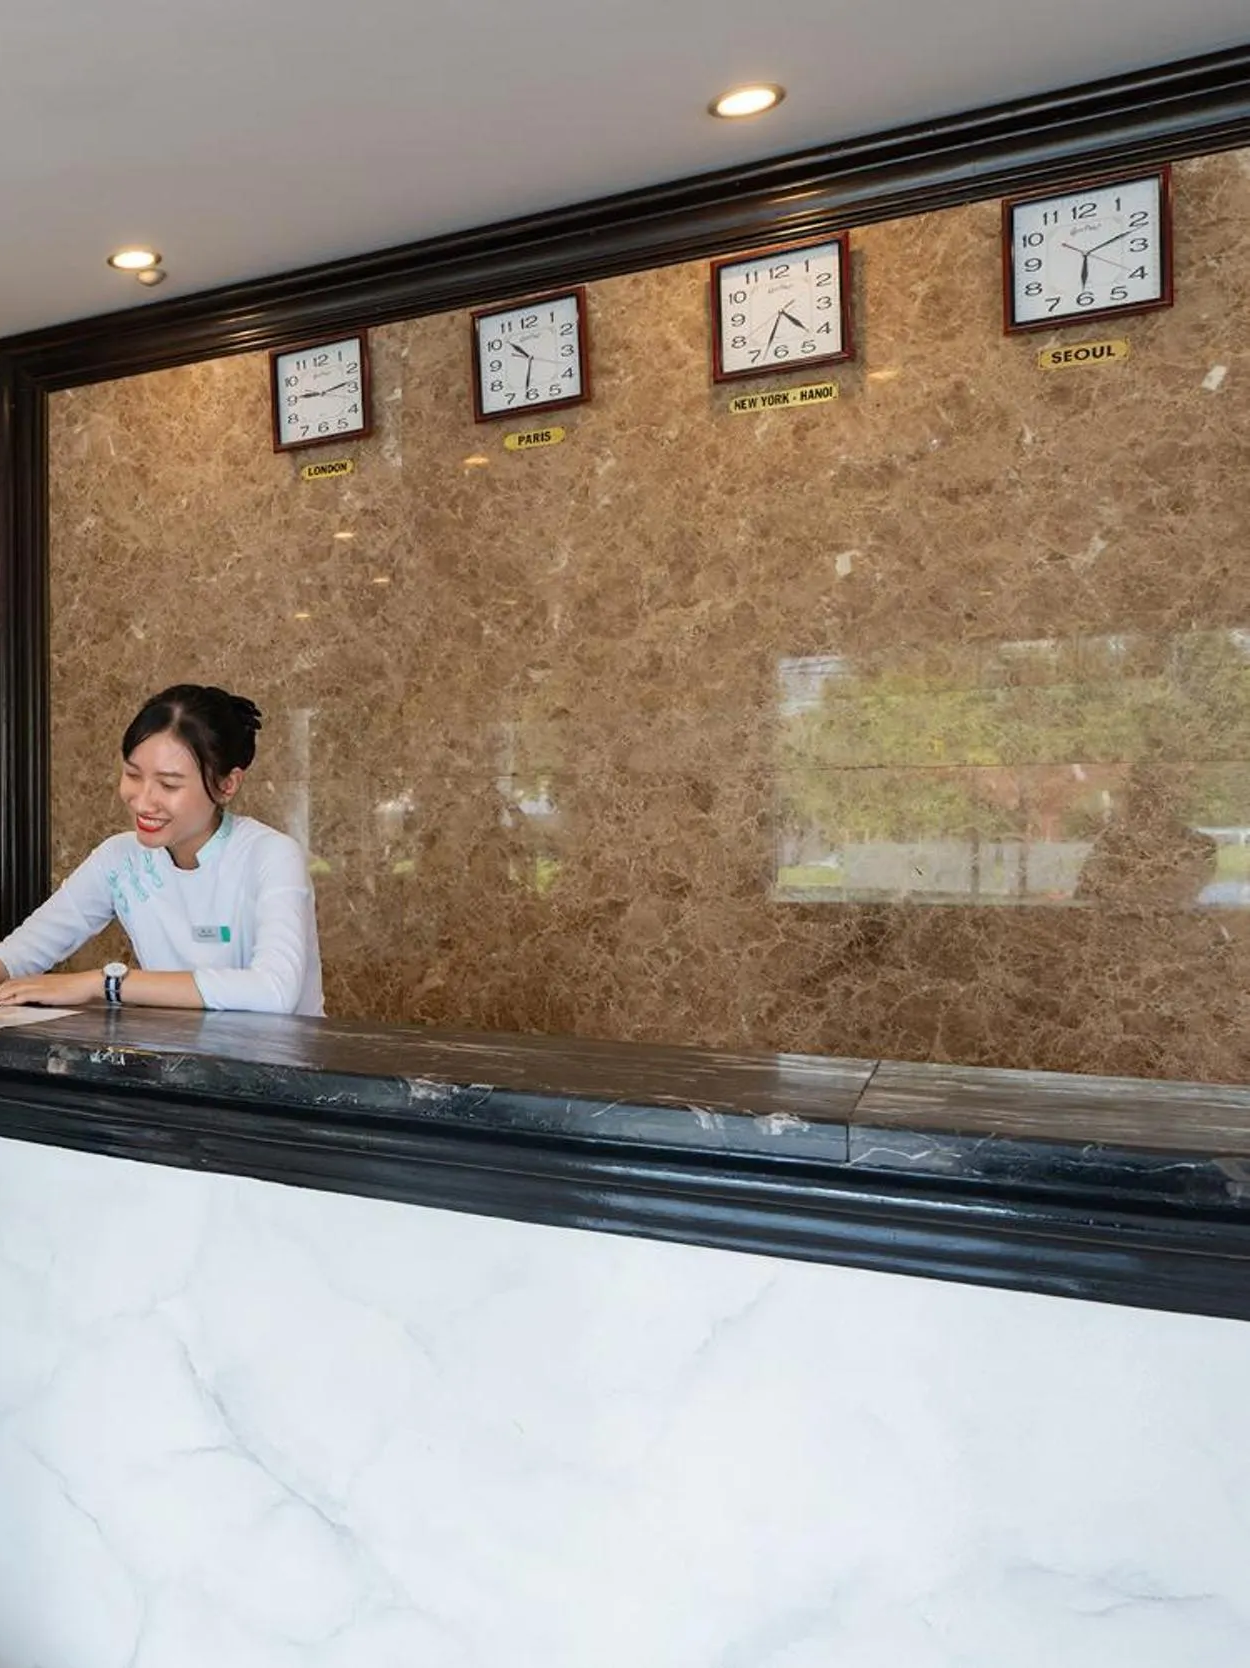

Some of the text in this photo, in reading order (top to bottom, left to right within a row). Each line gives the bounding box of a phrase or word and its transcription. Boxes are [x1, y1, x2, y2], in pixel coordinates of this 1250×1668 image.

[1042, 210, 1059, 226] 11
[1071, 202, 1098, 220] 12
[1128, 211, 1149, 228] 2
[1022, 232, 1044, 248] 10
[1129, 238, 1149, 252] 3
[768, 264, 790, 280] 12
[1024, 258, 1043, 272] 9
[745, 270, 758, 285] 11
[1128, 265, 1148, 280] 4
[816, 272, 832, 288] 2
[1024, 282, 1043, 296] 8
[1110, 286, 1128, 301] 5
[728, 290, 747, 305] 10
[816, 296, 832, 310] 3
[1045, 296, 1061, 312] 7
[1076, 292, 1095, 307] 6
[520, 315, 538, 330] 12
[730, 312, 746, 328] 9
[500, 322, 512, 334] 11
[560, 322, 574, 337] 2
[816, 321, 832, 334] 4
[487, 339, 503, 352] 10
[731, 335, 747, 349] 8
[800, 339, 817, 354] 5
[560, 344, 574, 358] 3
[748, 350, 761, 364] 7
[773, 344, 790, 359] 6
[1051, 344, 1116, 365] SEOUL
[296, 360, 306, 371] 11
[312, 354, 329, 368] 12
[346, 360, 358, 374] 2
[490, 360, 502, 372] 9
[561, 367, 574, 379] 4
[284, 376, 299, 388] 10
[347, 380, 359, 394] 3
[490, 380, 504, 392] 8
[525, 388, 540, 401] 6
[549, 383, 562, 397] 5
[286, 394, 298, 407] 9
[504, 392, 516, 406] 7
[734, 397, 757, 410] NEW
[760, 392, 790, 407] YORK
[799, 386, 833, 402] HANOI
[348, 403, 358, 414] 4
[287, 413, 299, 424] 8
[337, 418, 349, 430] 5
[300, 425, 309, 437] 7
[318, 421, 330, 433] 6
[517, 431, 552, 446] PARIS
[307, 462, 347, 477] LONDON
